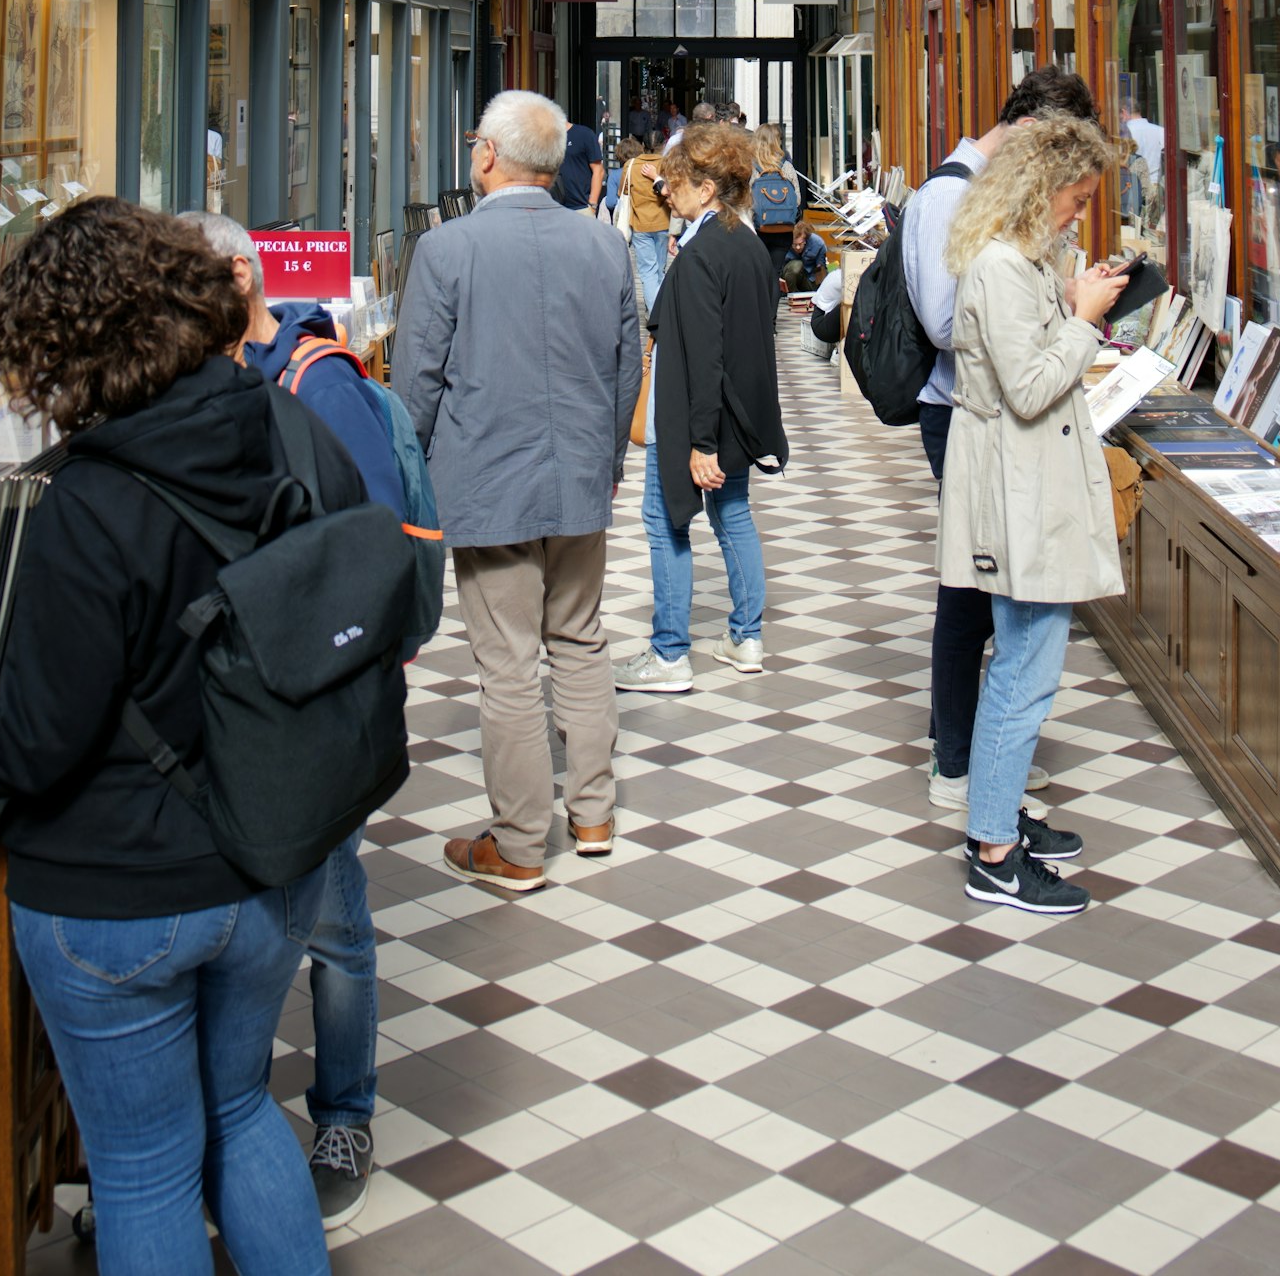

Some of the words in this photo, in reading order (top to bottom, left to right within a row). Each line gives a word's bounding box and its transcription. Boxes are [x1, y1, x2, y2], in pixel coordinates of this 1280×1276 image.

[251, 241, 303, 253] PECIAL
[306, 241, 347, 253] PRICE
[283, 260, 300, 272] 15
[302, 260, 312, 272] €
